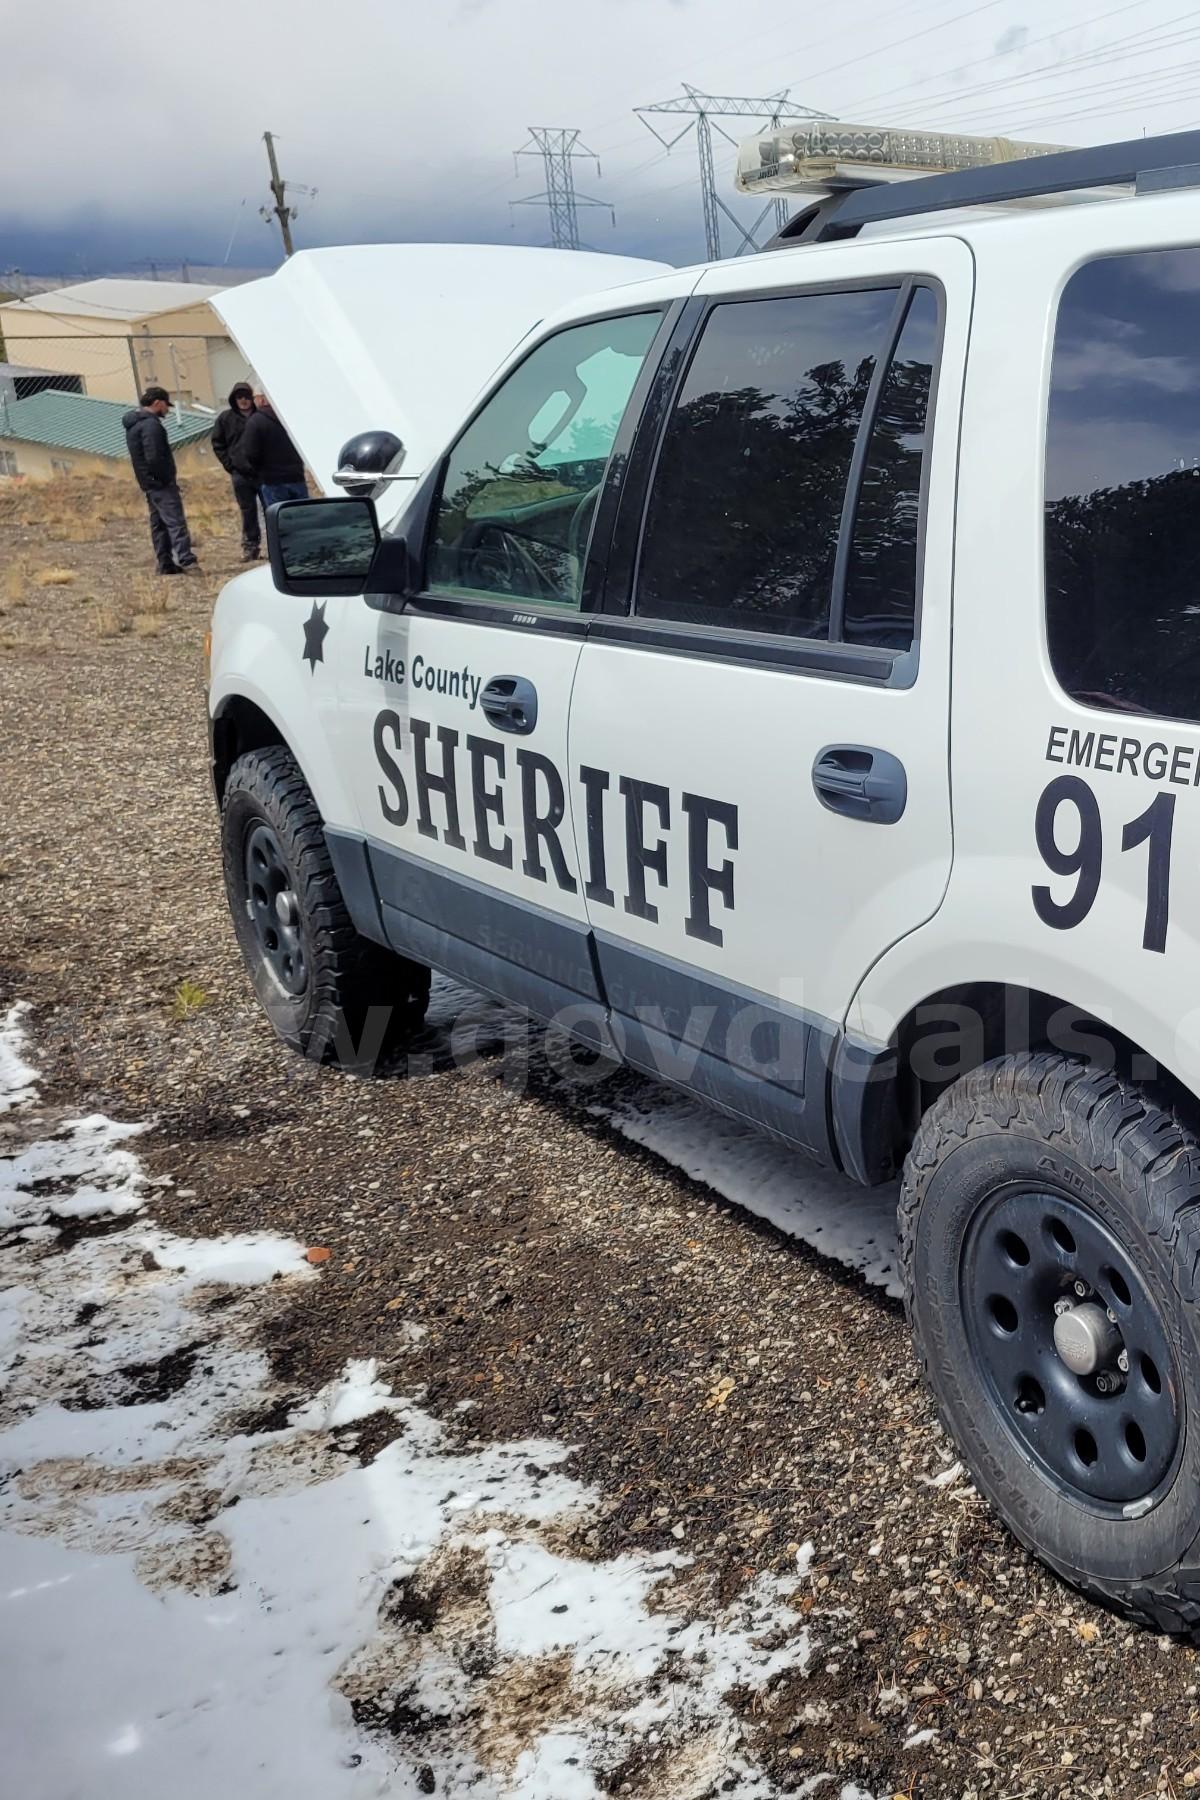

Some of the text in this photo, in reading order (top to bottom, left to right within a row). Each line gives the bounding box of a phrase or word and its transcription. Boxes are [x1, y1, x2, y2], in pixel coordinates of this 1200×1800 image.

[364, 645, 482, 708] Lake County
[373, 709, 739, 948] SHERIFF
